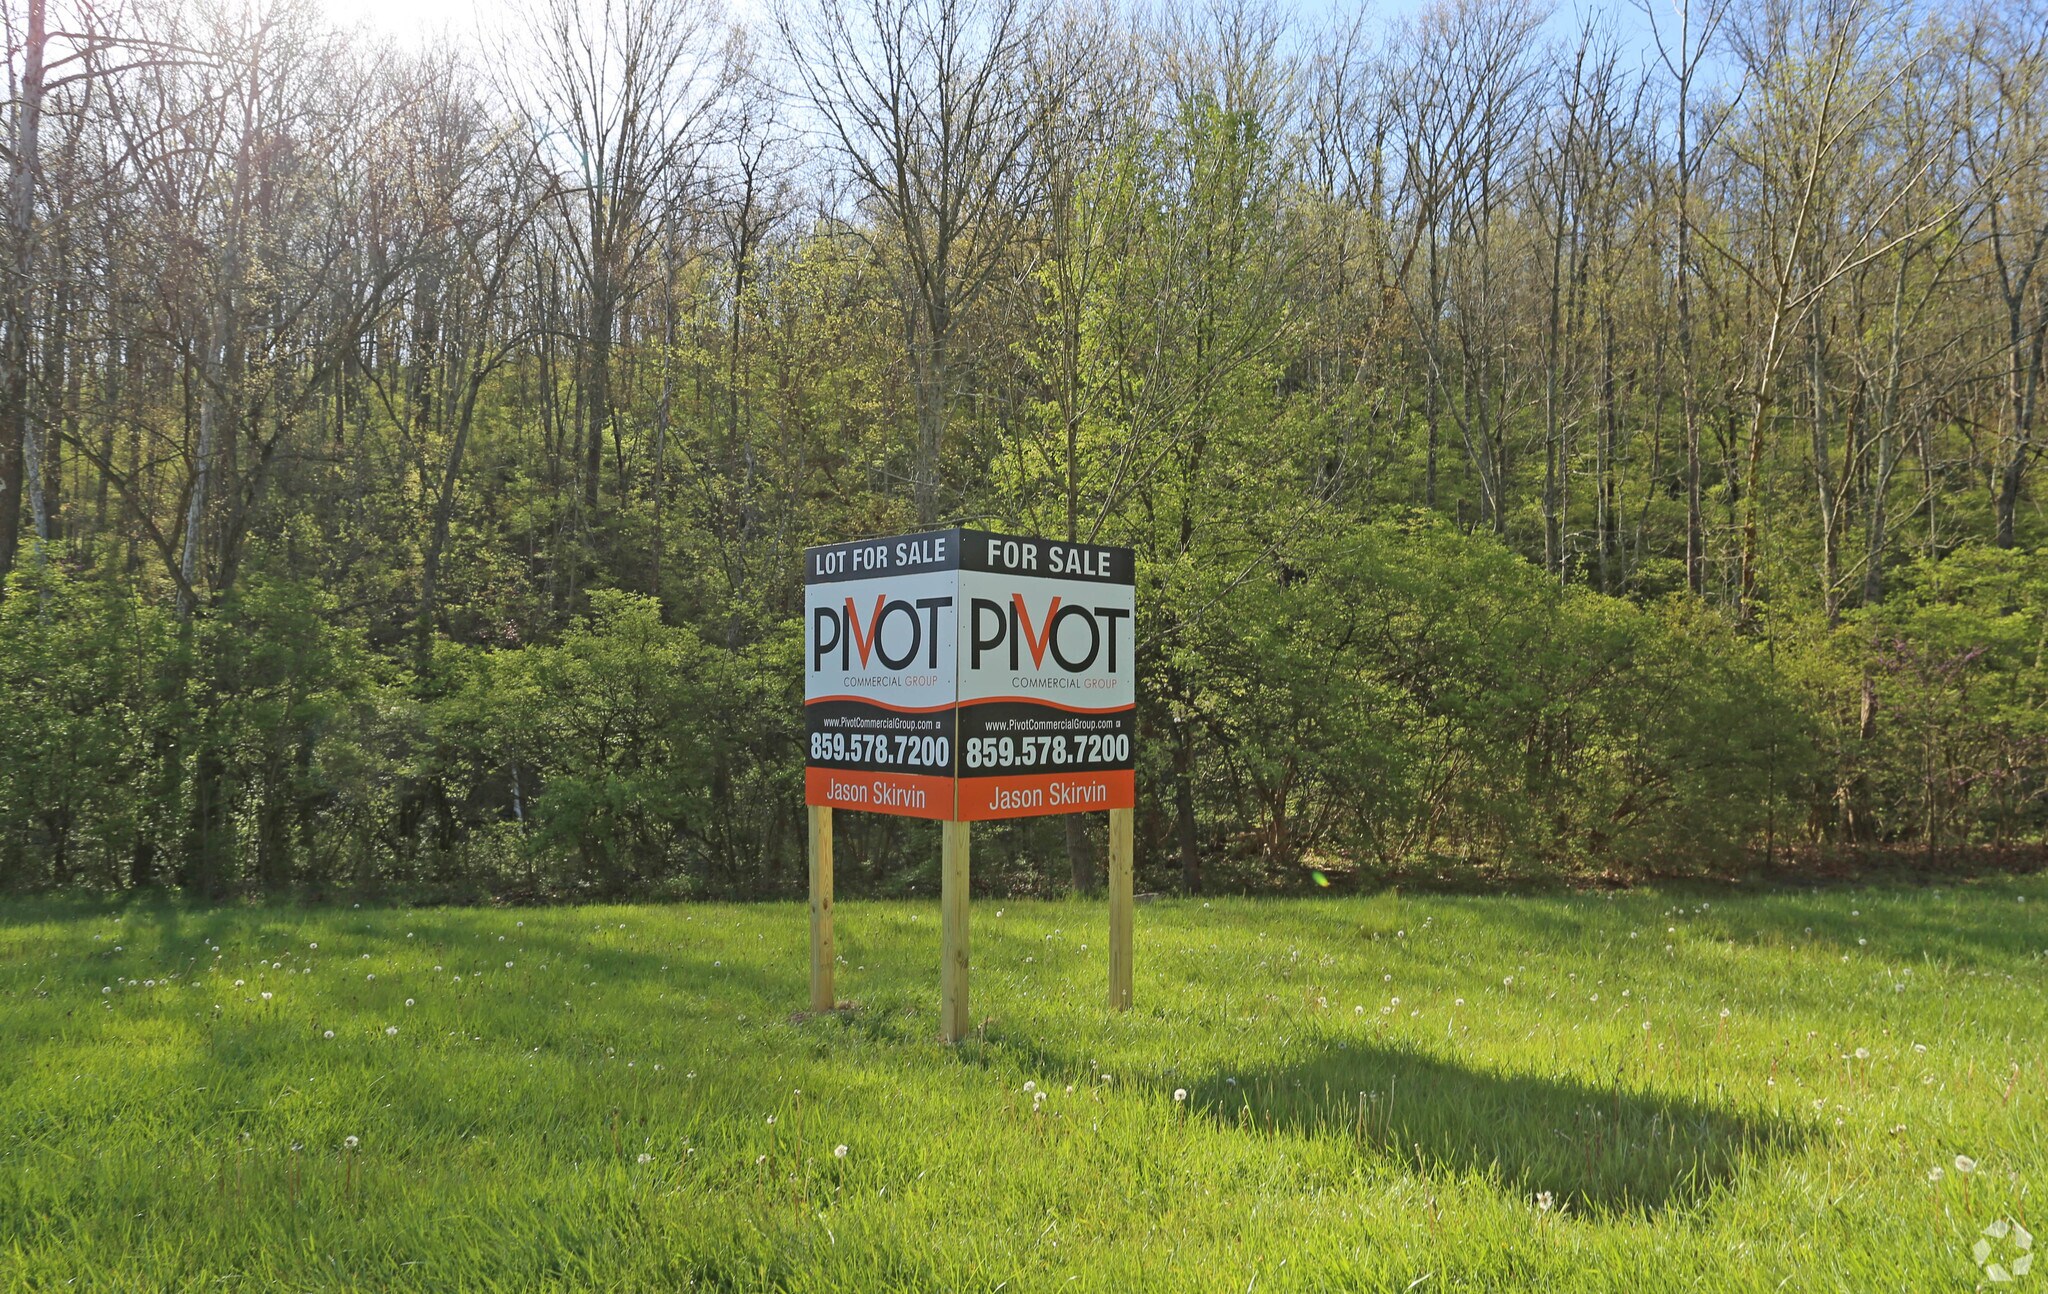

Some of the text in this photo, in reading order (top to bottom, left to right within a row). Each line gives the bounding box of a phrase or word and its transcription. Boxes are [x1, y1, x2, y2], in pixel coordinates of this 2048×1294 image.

[816, 537, 946, 575] LOT FOR SALE
[987, 539, 1111, 577] FOR SALE
[814, 594, 953, 672] PIVOT
[971, 593, 1130, 673] PIVOT
[843, 675, 938, 688] COMMERCIAL GROUP
[1012, 677, 1118, 689] COMMERCIAL GROUP
[823, 716, 933, 731] www.PivotCommercialGroup.com
[985, 718, 1113, 731] www.PivotCommercialGroup.com
[810, 732, 950, 768] 859.578.7200
[966, 734, 1129, 769] 859.578.7200
[826, 778, 926, 809] Jason Skirvin
[989, 780, 1106, 811] Jason Skirvin
